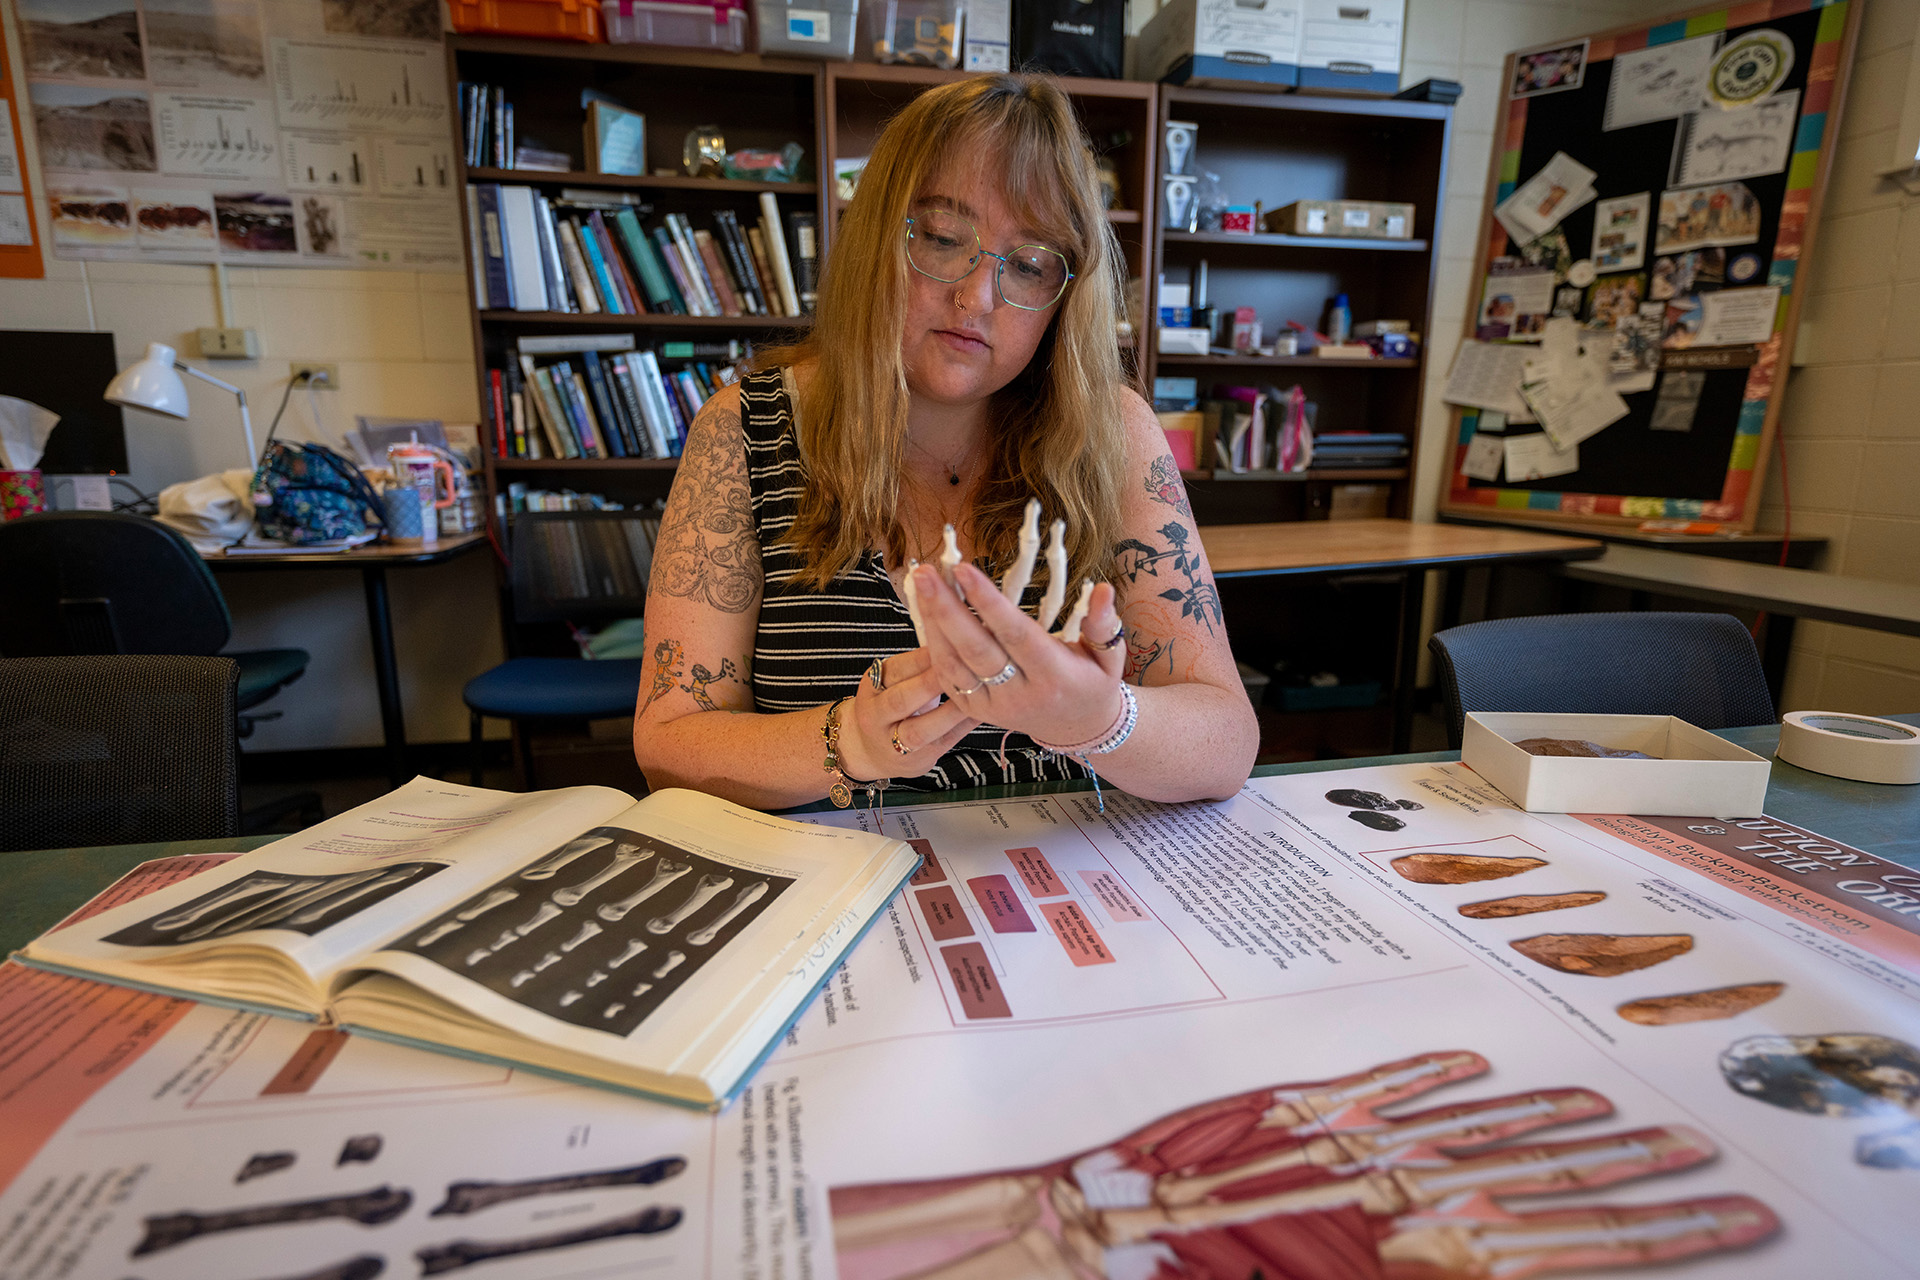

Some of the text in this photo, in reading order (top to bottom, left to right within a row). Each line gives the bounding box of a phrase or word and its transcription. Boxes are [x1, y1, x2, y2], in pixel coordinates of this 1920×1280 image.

[1458, 800, 1480, 814] Africa
[1213, 820, 1235, 836] humans
[1232, 835, 1252, 848] evolve
[1145, 847, 1160, 857] The
[1249, 847, 1264, 855] the
[1261, 830, 1334, 877] INTRODUCTION
[1153, 856, 1174, 873] results
[1258, 855, 1279, 869] ability
[1181, 869, 1209, 889] decided
[1201, 822, 1222, 835] struck
[1223, 840, 1238, 848] the
[1233, 847, 1260, 866] dramatic
[1256, 865, 1277, 877] shift
[1277, 883, 1302, 900] shape
[1296, 900, 1318, 912] and
[1309, 912, 1334, 927] style
[1327, 927, 1353, 943] from
[1211, 807, 1232, 822] symbols
[1248, 835, 1269, 849] human
[1293, 869, 1320, 887] 2012).
[1320, 891, 1347, 908] began
[1341, 907, 1363, 920] this
[1357, 920, 1385, 938] study
[1380, 938, 1409, 954] with
[1593, 817, 1857, 935] Biological and Cultural Anthropology
[1616, 818, 1871, 931] Caitlyn BucknerBackstrom
[1735, 839, 1838, 874] THE
[1836, 880, 1920, 921] OR
[1175, 878, 1191, 889] this
[1256, 879, 1276, 890] The
[1284, 875, 1311, 894] create
[1636, 882, 1669, 898] Homo
[1165, 839, 1181, 851] more
[1177, 851, 1214, 878] symmetrical
[1203, 877, 1224, 889] (see
[1215, 888, 1236, 899] Fig
[1251, 922, 1299, 959] refinements
[1184, 889, 1207, 906] study
[1190, 849, 1203, 858] use
[1211, 868, 1237, 887] lengthy
[1228, 886, 1260, 906] period
[1248, 906, 1272, 920] (see
[1262, 919, 1286, 930] Fig
[1274, 930, 1297, 939] 2).
[1287, 939, 1313, 957] Over
[1199, 843, 1223, 862] handaxe
[1217, 862, 1235, 871] may
[1230, 870, 1246, 878] be
[1239, 878, 1279, 907] associated
[1269, 907, 1294, 921] with
[1291, 926, 1322, 948] higher
[1315, 947, 1343, 964] level
[1268, 891, 1290, 902] skill
[1305, 893, 1327, 905] art?
[1641, 896, 1677, 913] Africa
[1164, 884, 1198, 914] archeology
[1191, 913, 1213, 924] and
[1202, 924, 1237, 948] cultural
[1200, 905, 1218, 916] are
[1208, 896, 1239, 920] examine
[1282, 903, 1310, 922] shown
[1311, 830, 1326, 841] and
[1323, 837, 1355, 863] Paleolithic
[1354, 861, 1372, 876] stone
[1373, 873, 1394, 890] tools.
[1394, 889, 1414, 902] Note
[1413, 900, 1429, 913] the
[1428, 912, 1477, 944] refinement
[1475, 942, 1490, 951] of
[1487, 950, 1513, 968] tools
[1513, 966, 1526, 978] as
[1526, 976, 1552, 995] time
[1320, 905, 1338, 913] In
[888, 909, 902, 925] chart
[1210, 915, 1228, 923] of
[1232, 919, 1253, 930] the
[1303, 921, 1321, 929] in
[1326, 913, 1348, 923] my
[893, 924, 907, 937] with
[1076, 920, 1089, 933] Stone
[1084, 934, 1096, 944] Age
[1218, 922, 1253, 946] interest
[1311, 929, 1335, 941] the
[1342, 923, 1377, 945] search
[1242, 930, 1268, 948] value
[896, 937, 917, 966] suspected
[1242, 946, 1262, 955] to
[1260, 947, 1280, 956] of
[1368, 945, 1391, 956] for
[1269, 956, 1294, 970] the
[837, 971, 853, 984] the
[840, 984, 858, 1002] level
[845, 1002, 860, 1012] of
